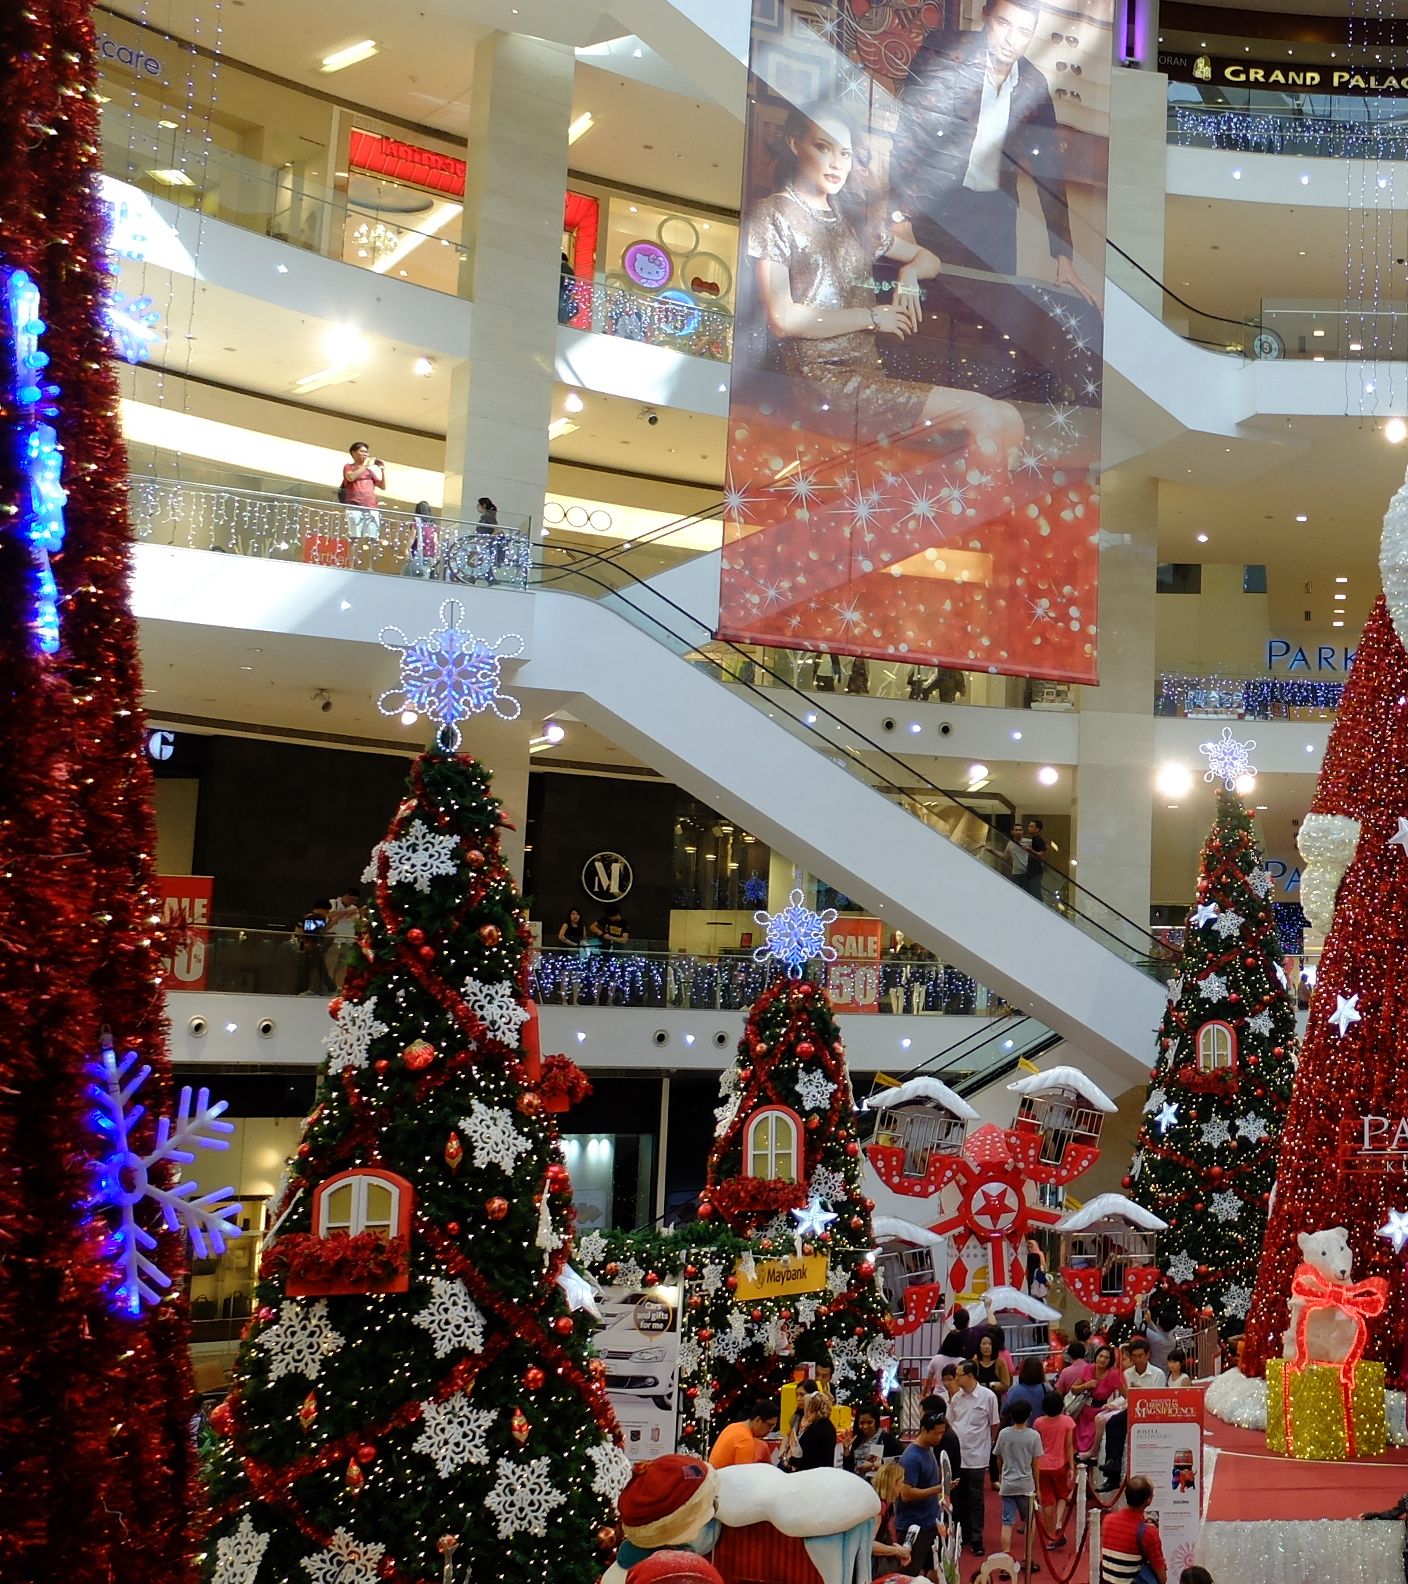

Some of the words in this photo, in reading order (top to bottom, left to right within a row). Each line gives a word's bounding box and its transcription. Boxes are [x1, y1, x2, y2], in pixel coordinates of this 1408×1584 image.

[1224, 65, 1321, 86] GRAND
[149, 731, 175, 760] G
[832, 934, 878, 957] SALE
[767, 1264, 808, 1286] Maybank
[637, 1311, 650, 1320] and
[651, 1311, 668, 1321] gifts
[645, 1302, 662, 1310] Cars
[640, 1321, 651, 1330] for
[651, 1321, 664, 1330] me
